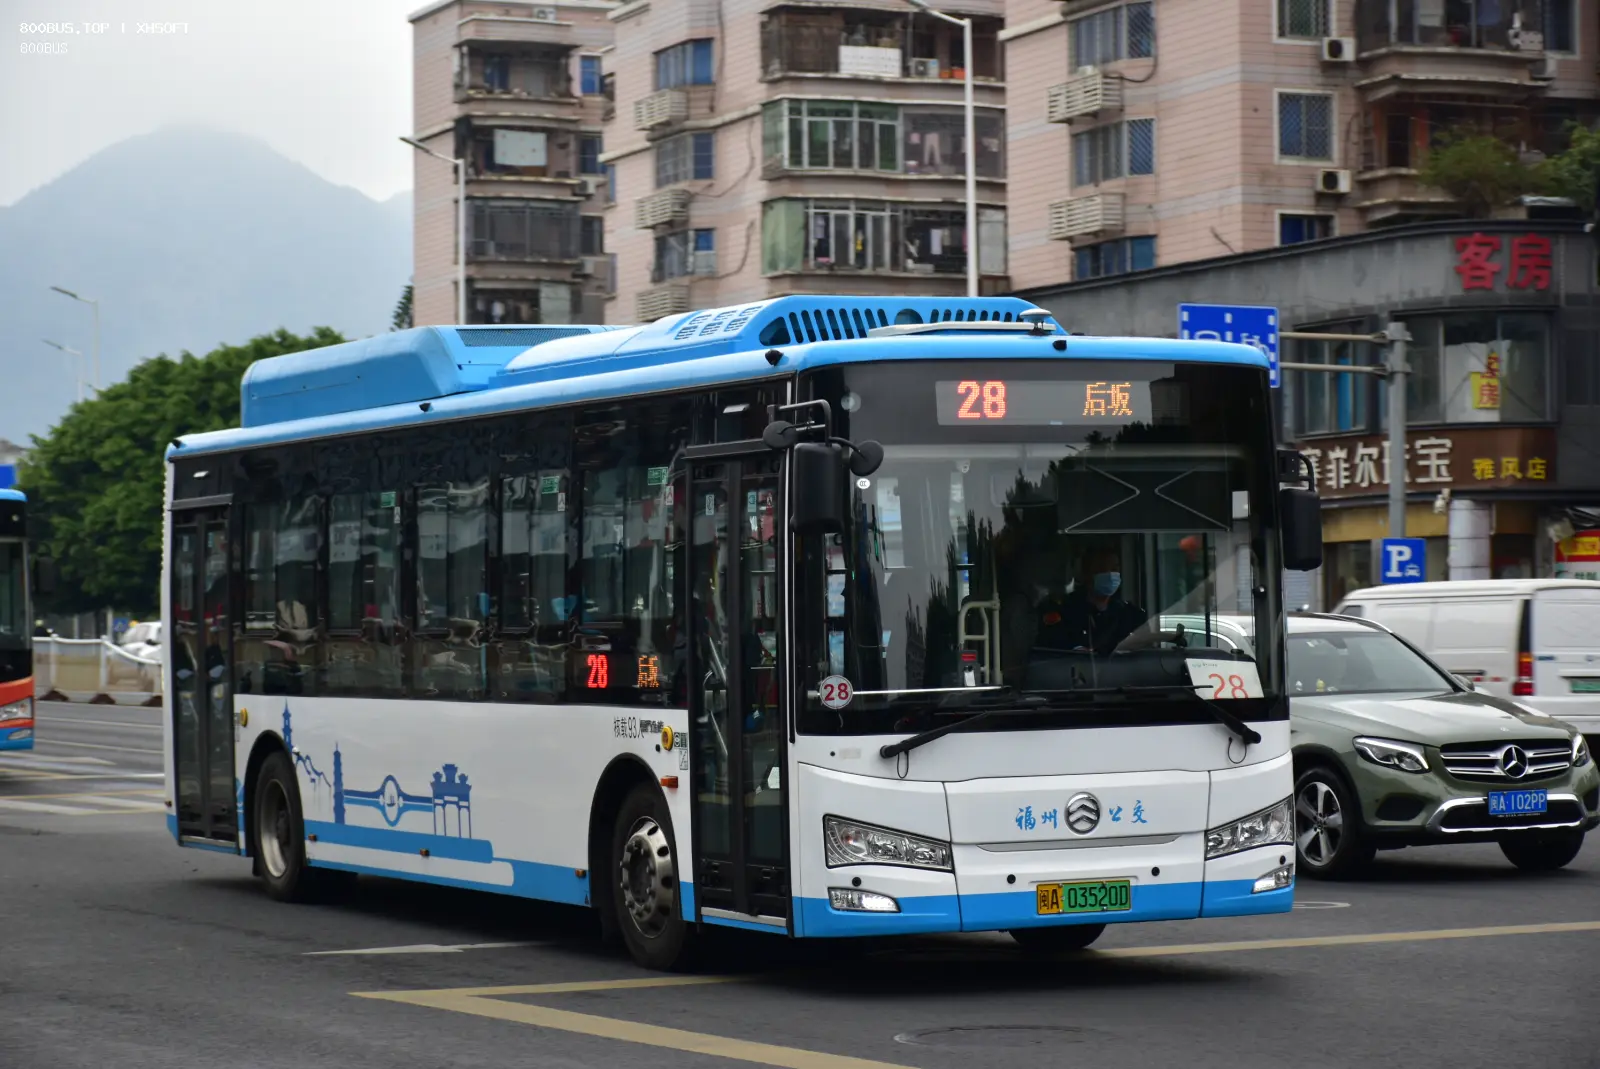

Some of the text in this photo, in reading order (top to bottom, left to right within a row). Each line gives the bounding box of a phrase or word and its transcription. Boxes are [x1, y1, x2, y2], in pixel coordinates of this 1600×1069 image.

[1454, 232, 1552, 290] 客房
[957, 380, 1006, 419] 28
[1082, 381, 1133, 416] 后坂
[1472, 457, 1548, 481] 雅风店
[1386, 544, 1412, 578] P
[586, 654, 608, 688] 28
[1208, 673, 1249, 699] 28
[823, 682, 849, 702] 28
[1015, 800, 1148, 831] 福州 公交
